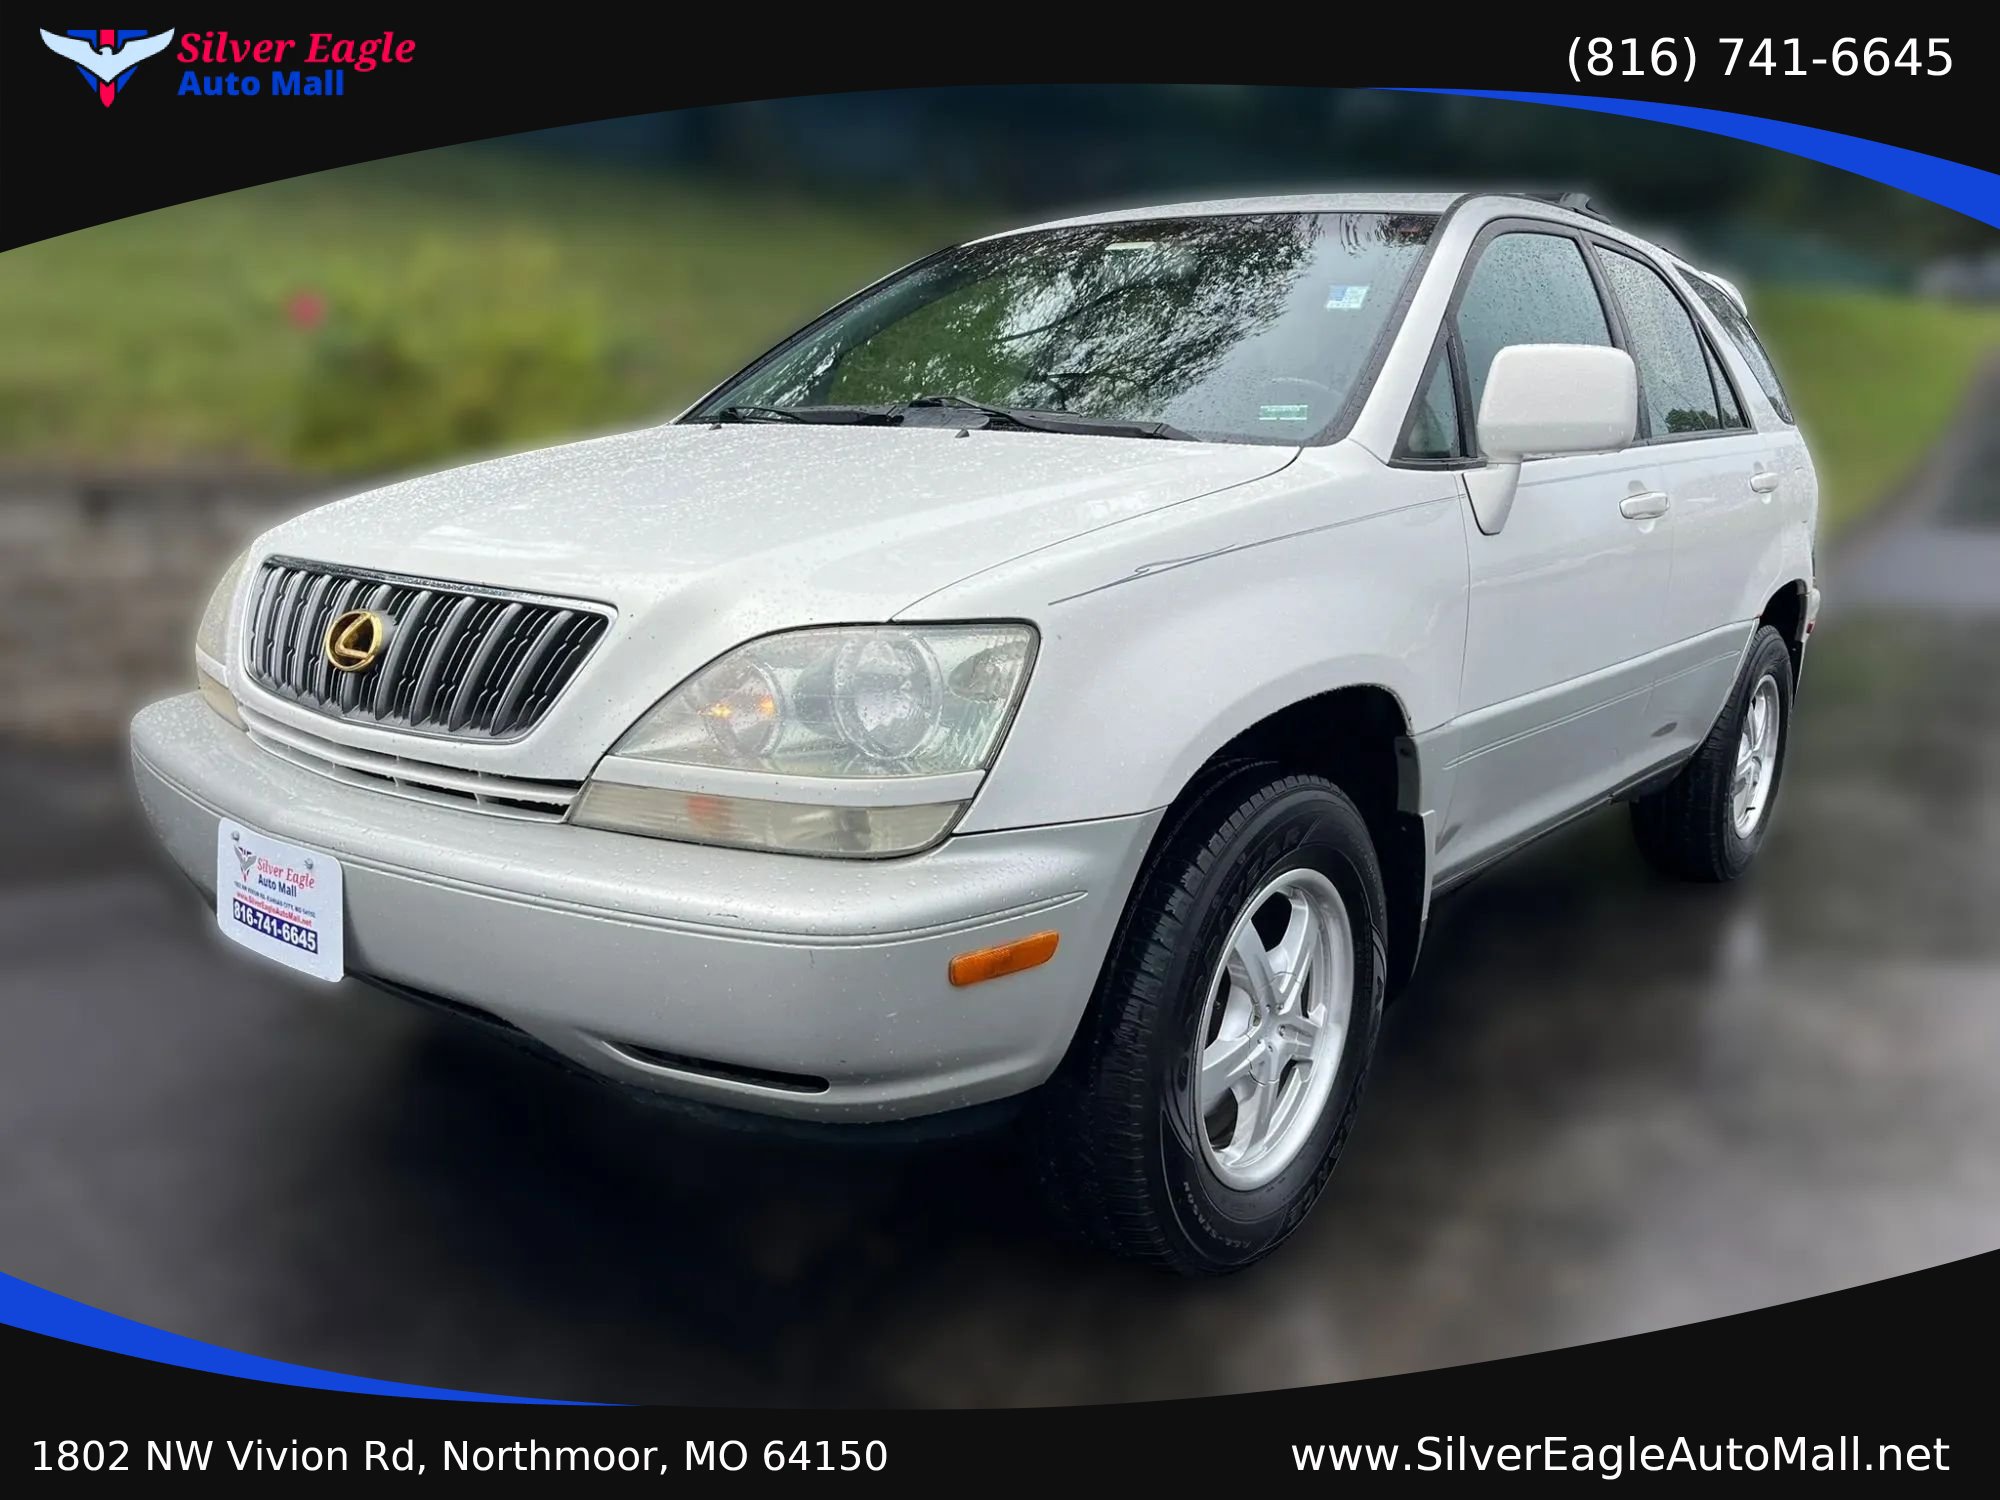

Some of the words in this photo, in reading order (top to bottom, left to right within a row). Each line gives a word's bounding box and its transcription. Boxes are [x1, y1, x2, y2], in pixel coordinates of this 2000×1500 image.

[257, 857, 284, 877] Silver
[286, 868, 315, 890] Eagle
[258, 874, 277, 890] Auto
[279, 881, 297, 898] Mall
[234, 901, 317, 951] 816-741-6645
